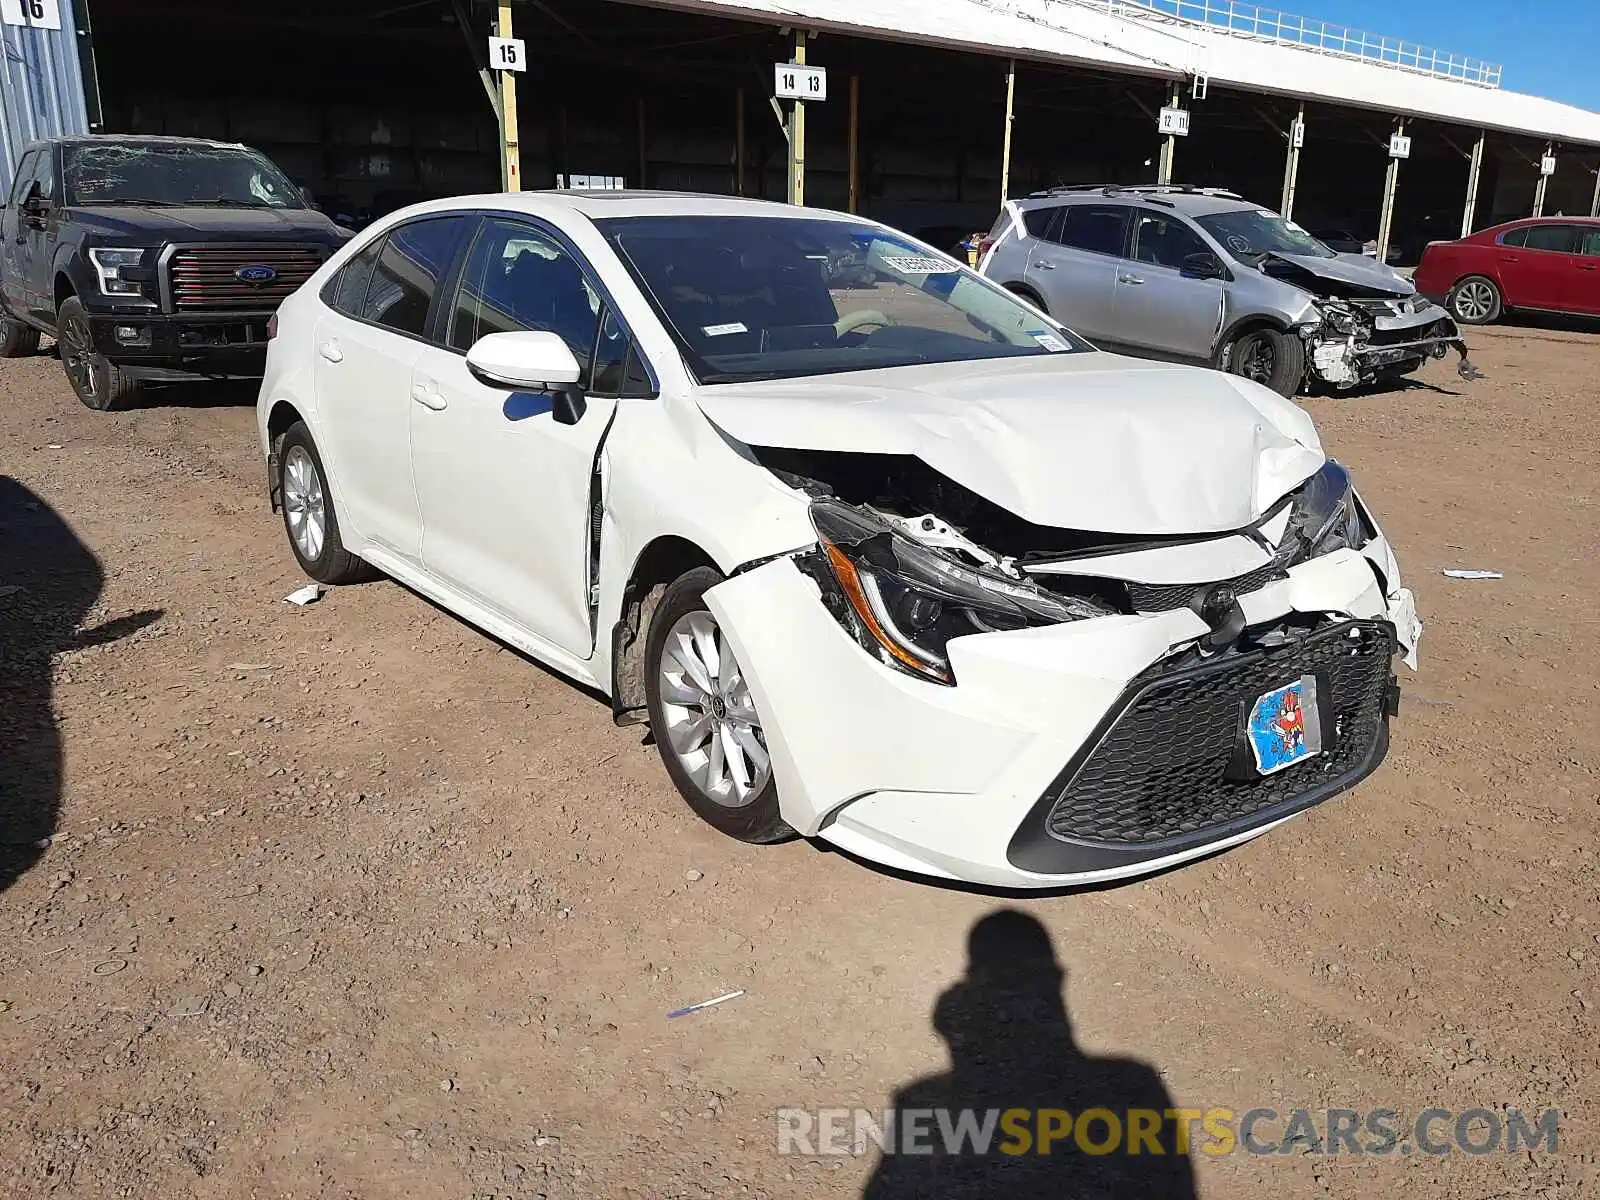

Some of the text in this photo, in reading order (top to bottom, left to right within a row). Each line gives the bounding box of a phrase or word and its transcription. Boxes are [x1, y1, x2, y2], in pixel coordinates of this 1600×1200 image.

[499, 45, 516, 64] 15
[782, 73, 820, 92] 14 13
